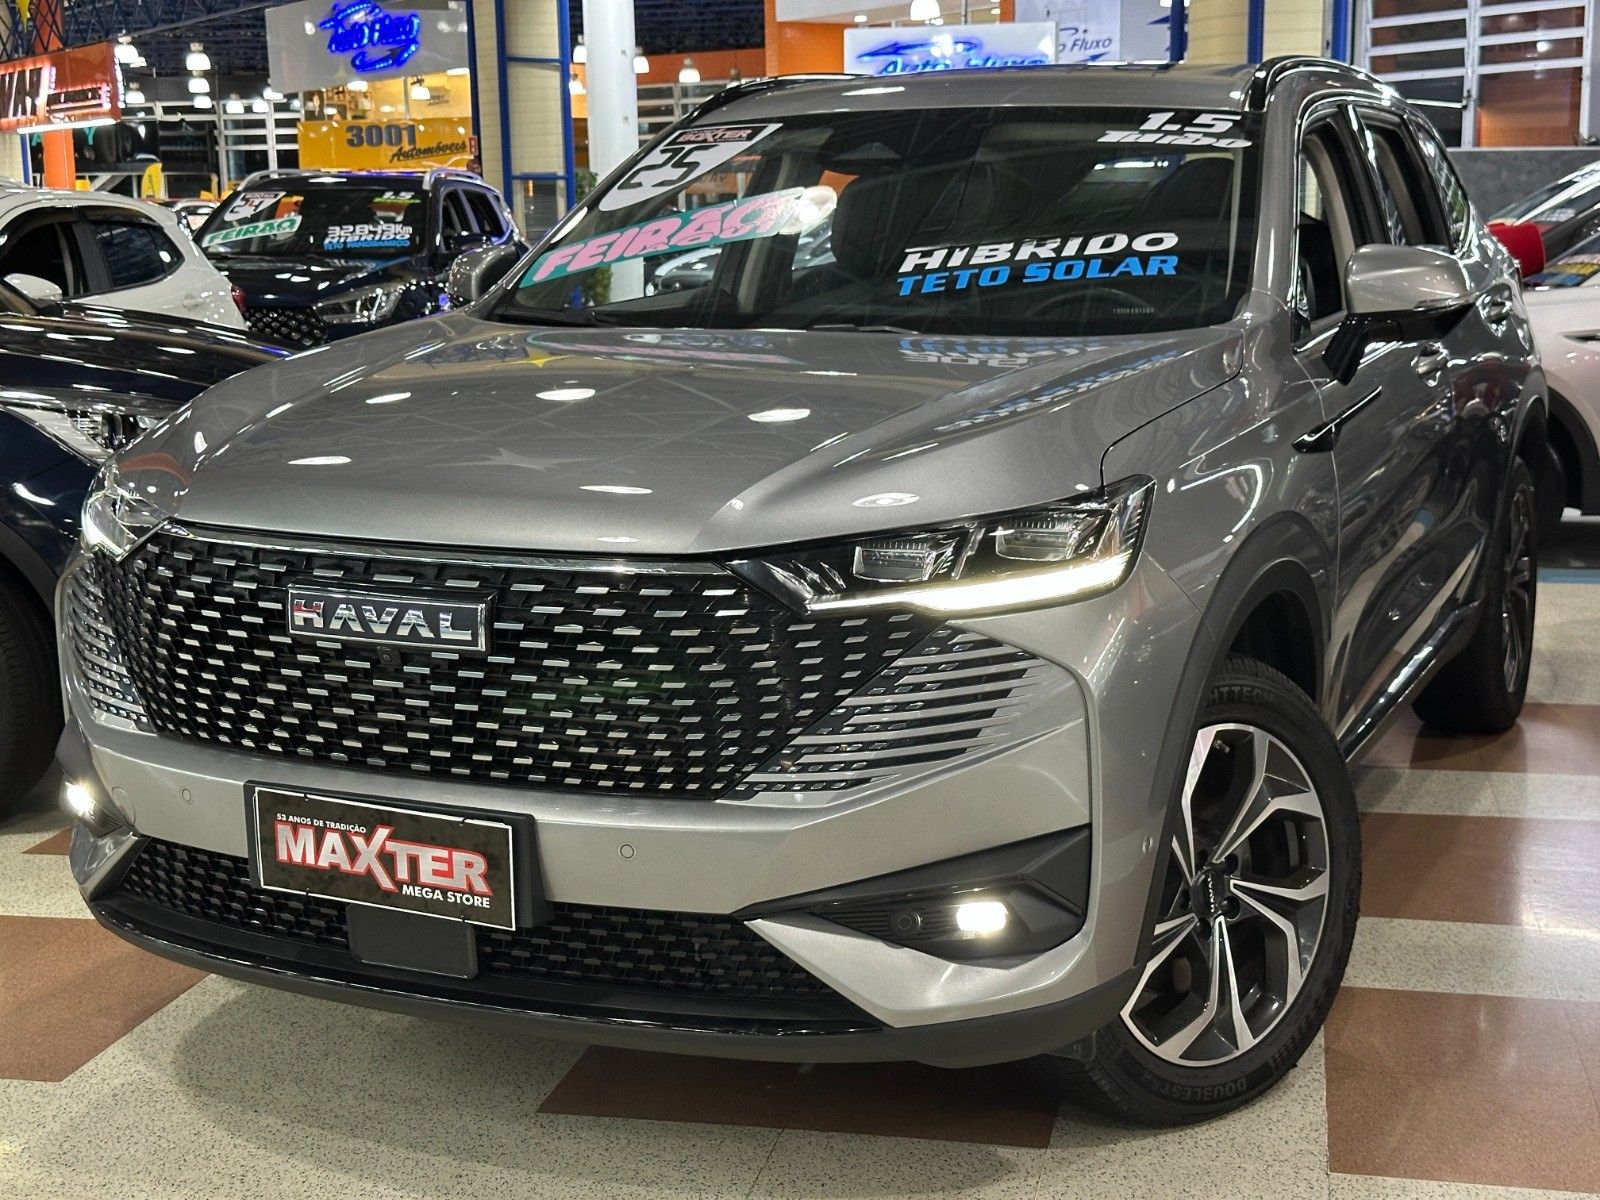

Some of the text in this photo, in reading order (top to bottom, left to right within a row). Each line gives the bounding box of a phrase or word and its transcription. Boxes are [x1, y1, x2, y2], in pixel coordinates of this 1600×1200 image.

[1072, 37, 1112, 53] Fluxo
[1139, 111, 1242, 133] 1.5
[346, 124, 416, 147] 3001
[617, 144, 719, 190] 25
[897, 255, 1179, 296] TETO SOLAR
[293, 599, 473, 641] HAVAL
[276, 813, 367, 834] 53 ANOS DE TRADIÇÃO
[275, 824, 493, 896] MAXTER
[402, 884, 491, 908] MEGA STORE
